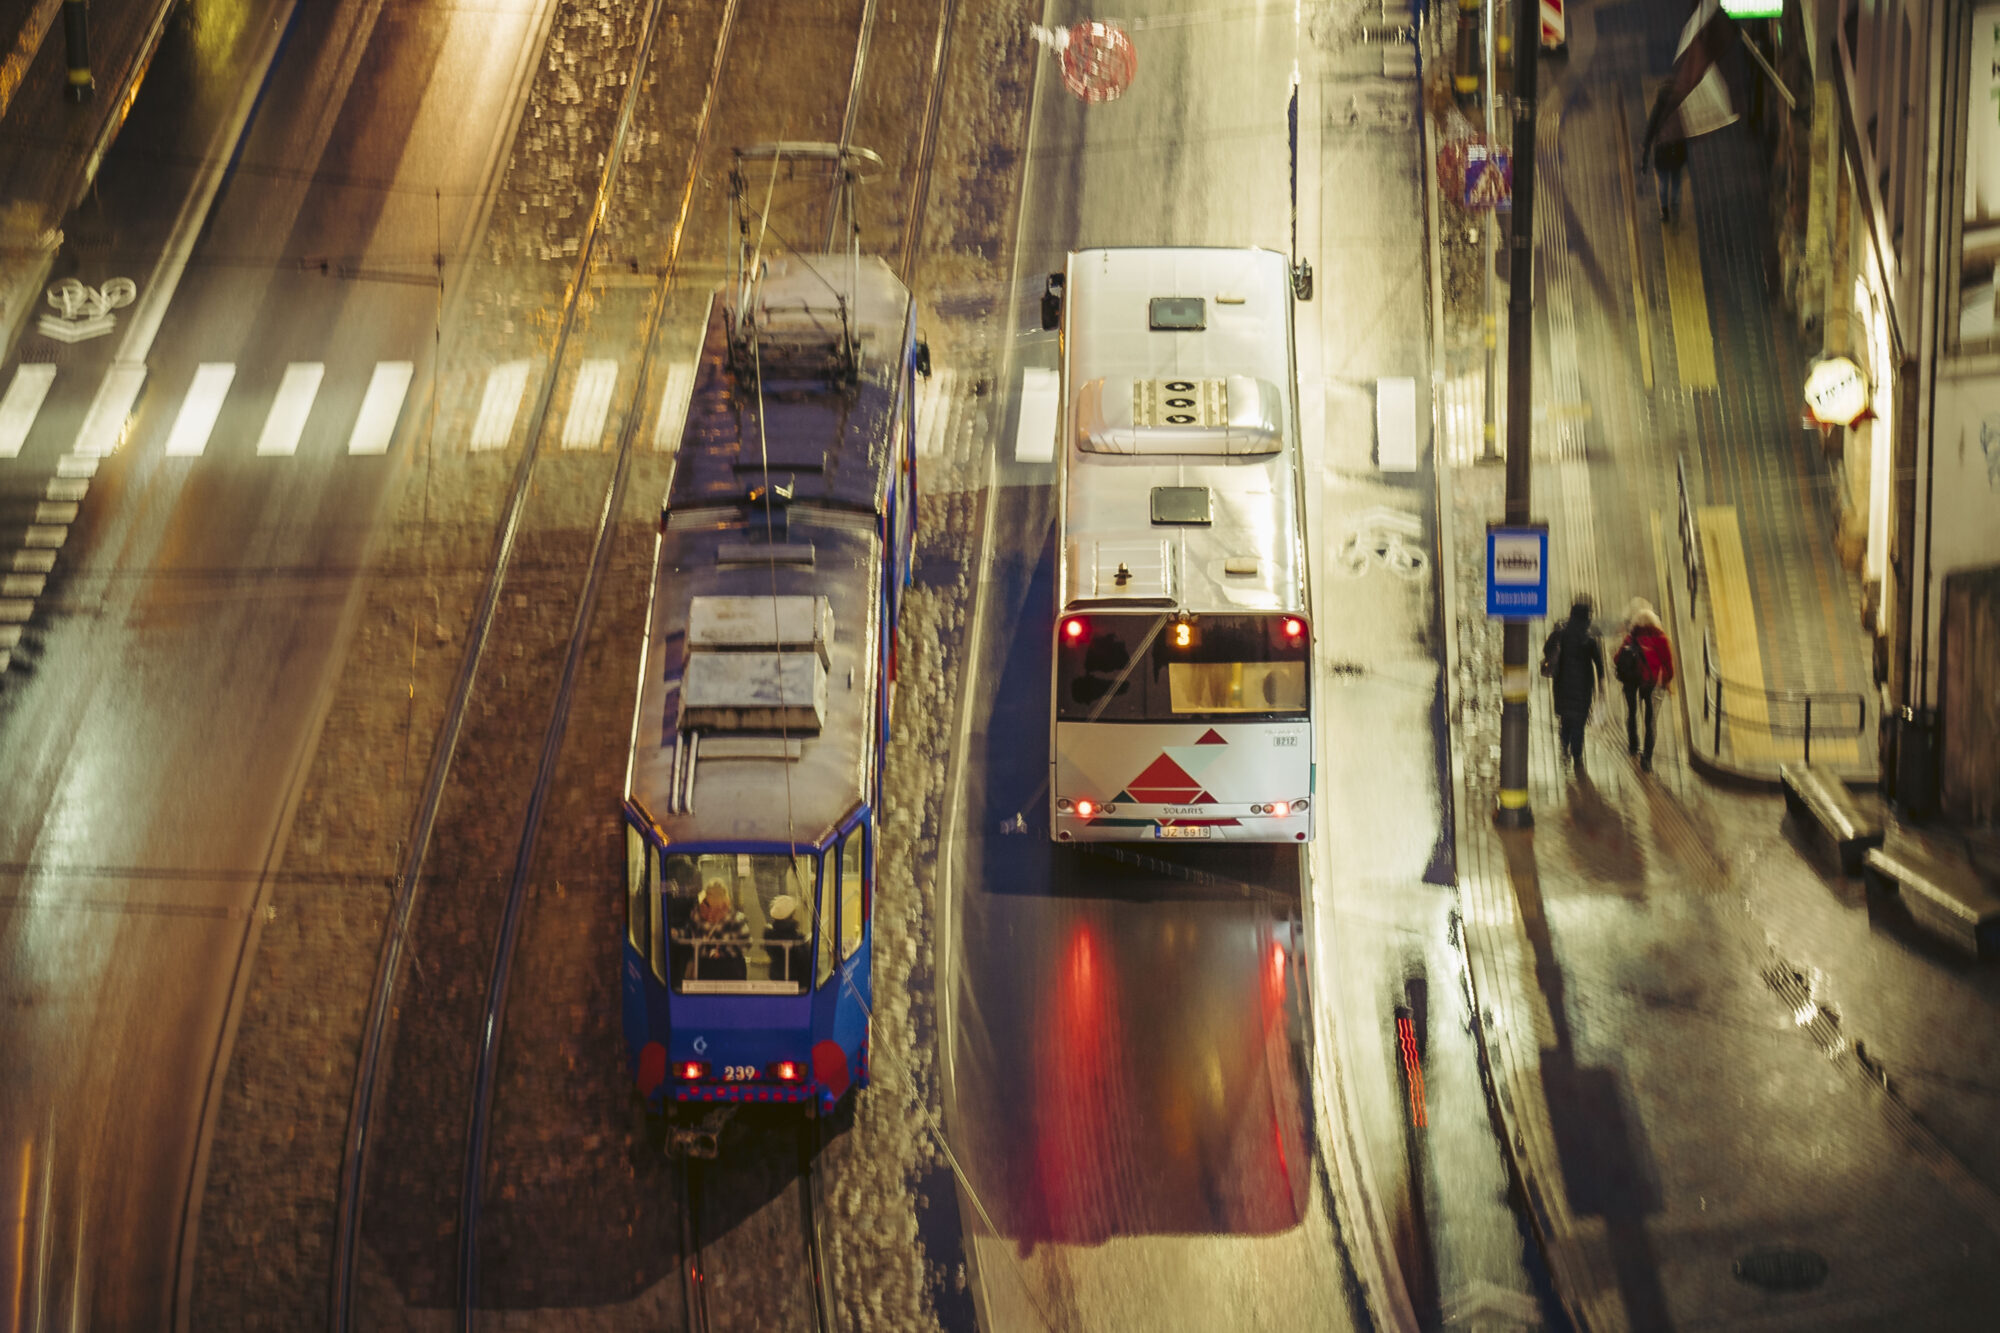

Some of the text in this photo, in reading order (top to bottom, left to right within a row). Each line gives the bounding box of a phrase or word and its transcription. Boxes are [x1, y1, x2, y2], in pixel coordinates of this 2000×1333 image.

[1176, 623, 1190, 646] 3
[1163, 807, 1204, 815] SOLARIS
[724, 1065, 756, 1081] 239
